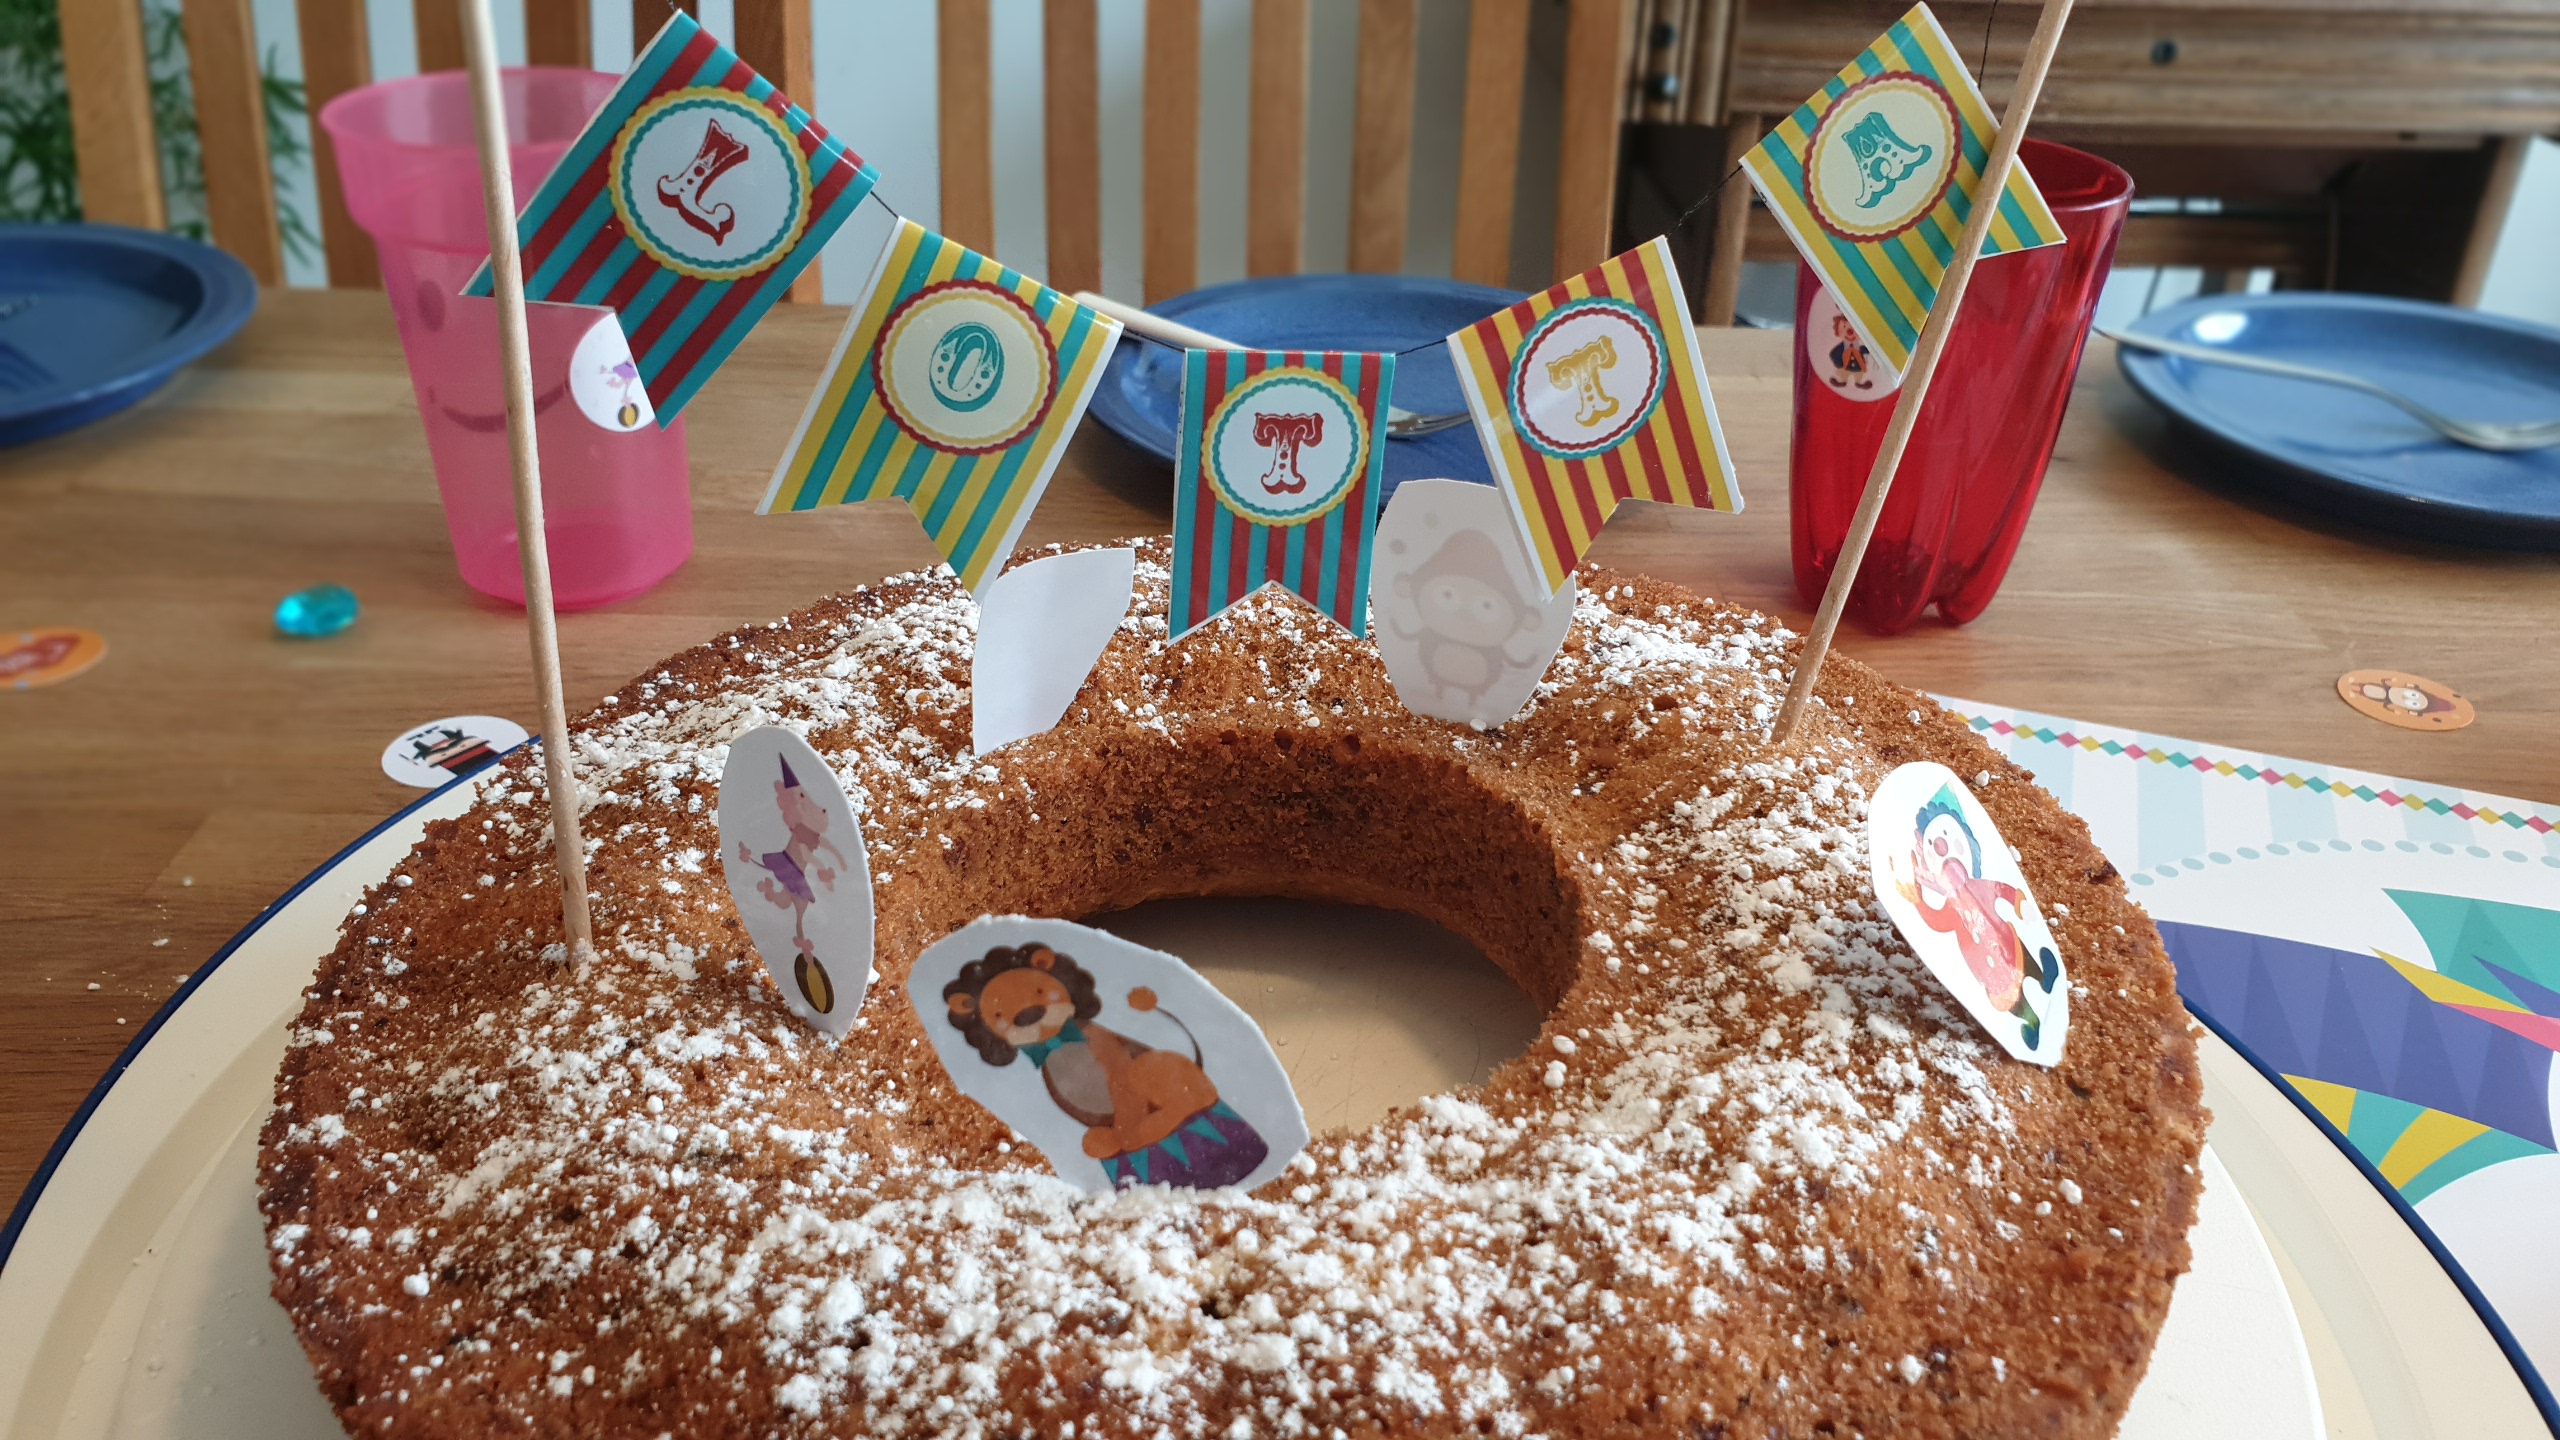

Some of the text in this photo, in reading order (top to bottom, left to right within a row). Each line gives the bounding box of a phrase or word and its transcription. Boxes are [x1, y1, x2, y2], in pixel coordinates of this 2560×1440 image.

[656, 111, 1933, 495] L O T T A
